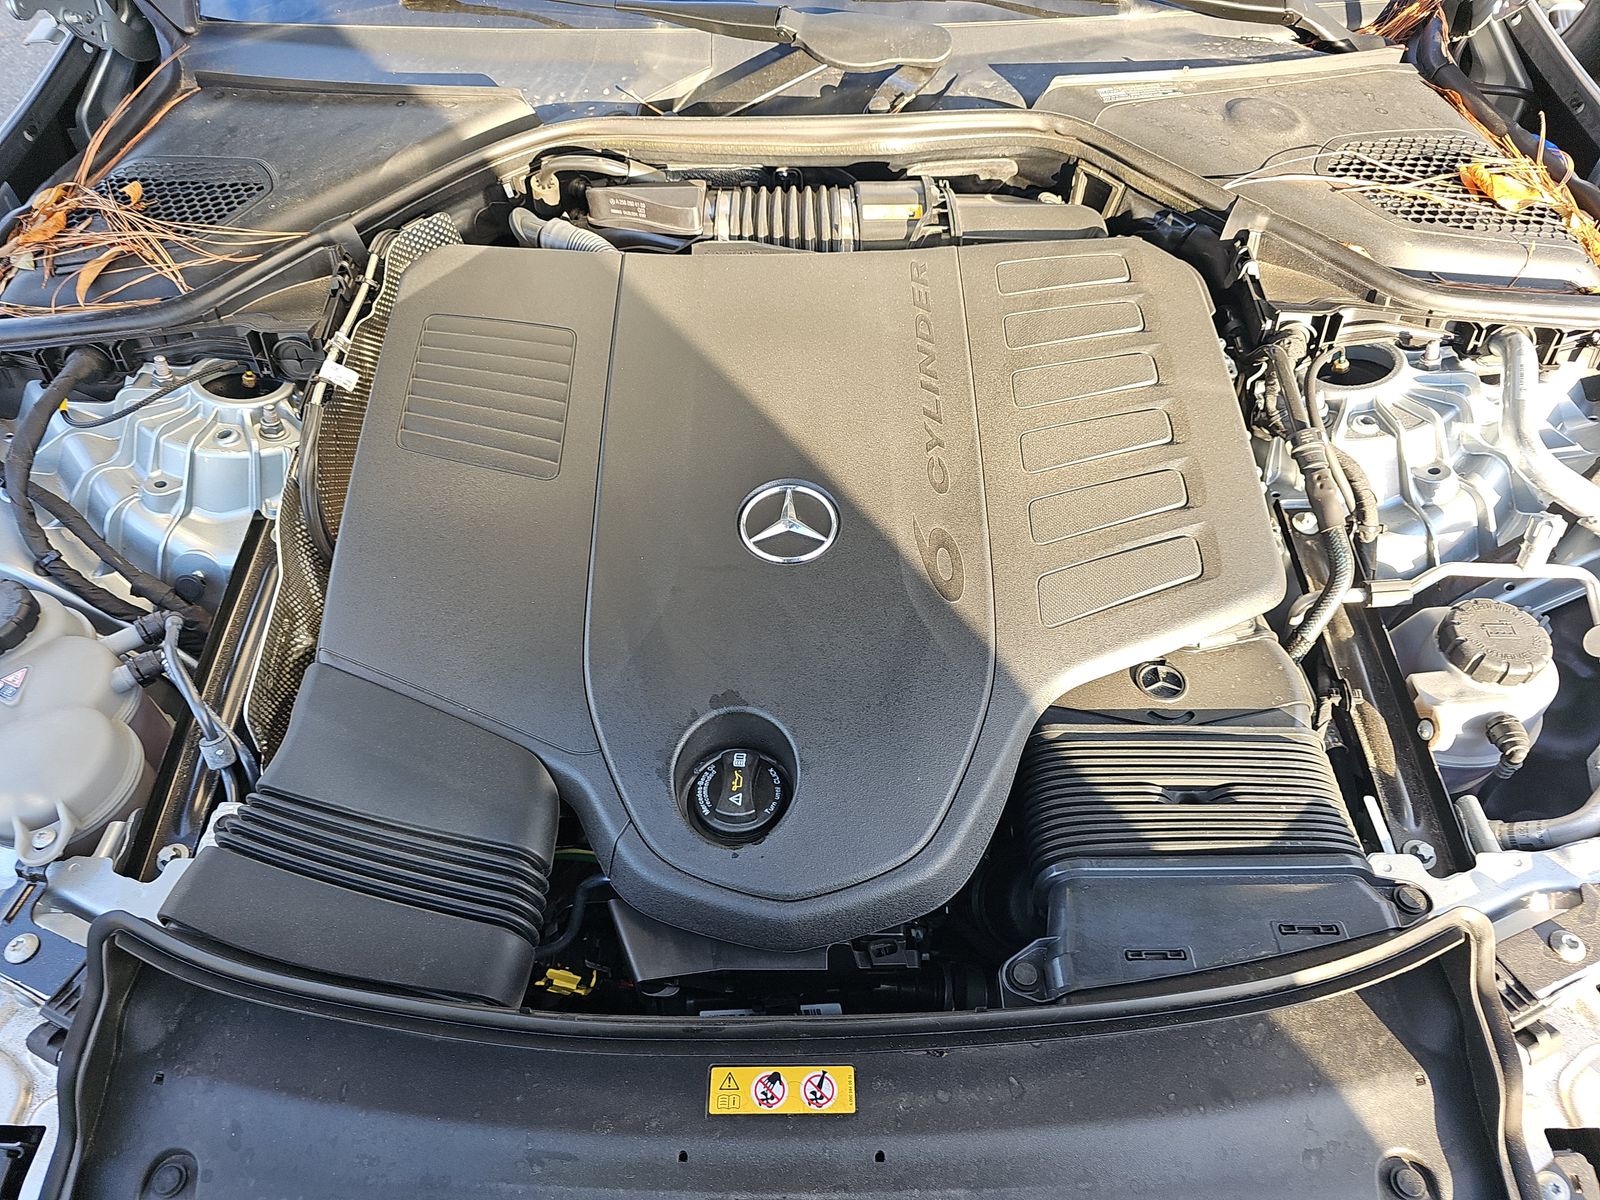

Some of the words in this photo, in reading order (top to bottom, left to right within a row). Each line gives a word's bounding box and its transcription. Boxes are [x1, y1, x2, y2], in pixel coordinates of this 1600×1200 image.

[910, 260, 951, 495] CYLINDER
[912, 513, 965, 603] 6
[764, 802, 778, 815] Turn
[774, 786, 782, 801] until
